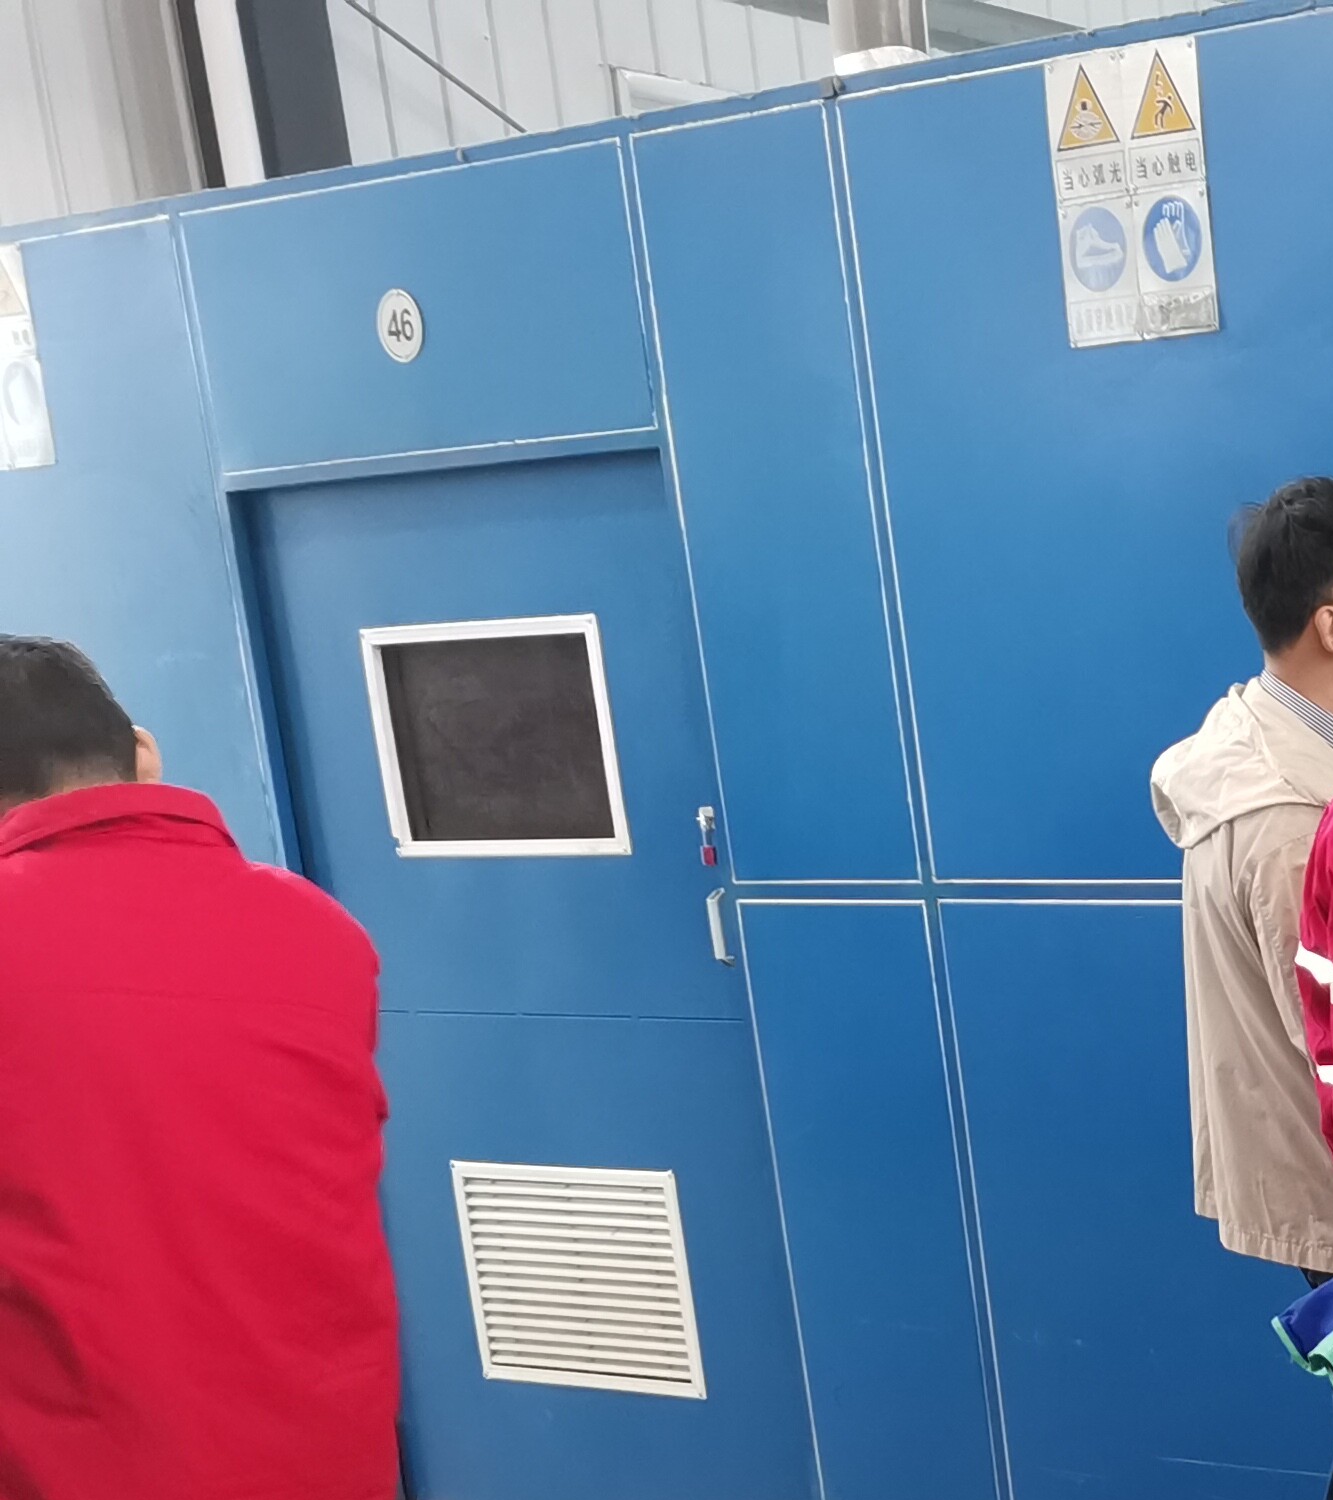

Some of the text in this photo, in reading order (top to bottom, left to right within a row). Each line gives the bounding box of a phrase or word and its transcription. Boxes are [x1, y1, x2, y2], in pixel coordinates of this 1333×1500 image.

[1136, 150, 1198, 180] 当心触电
[387, 308, 415, 342] 46
